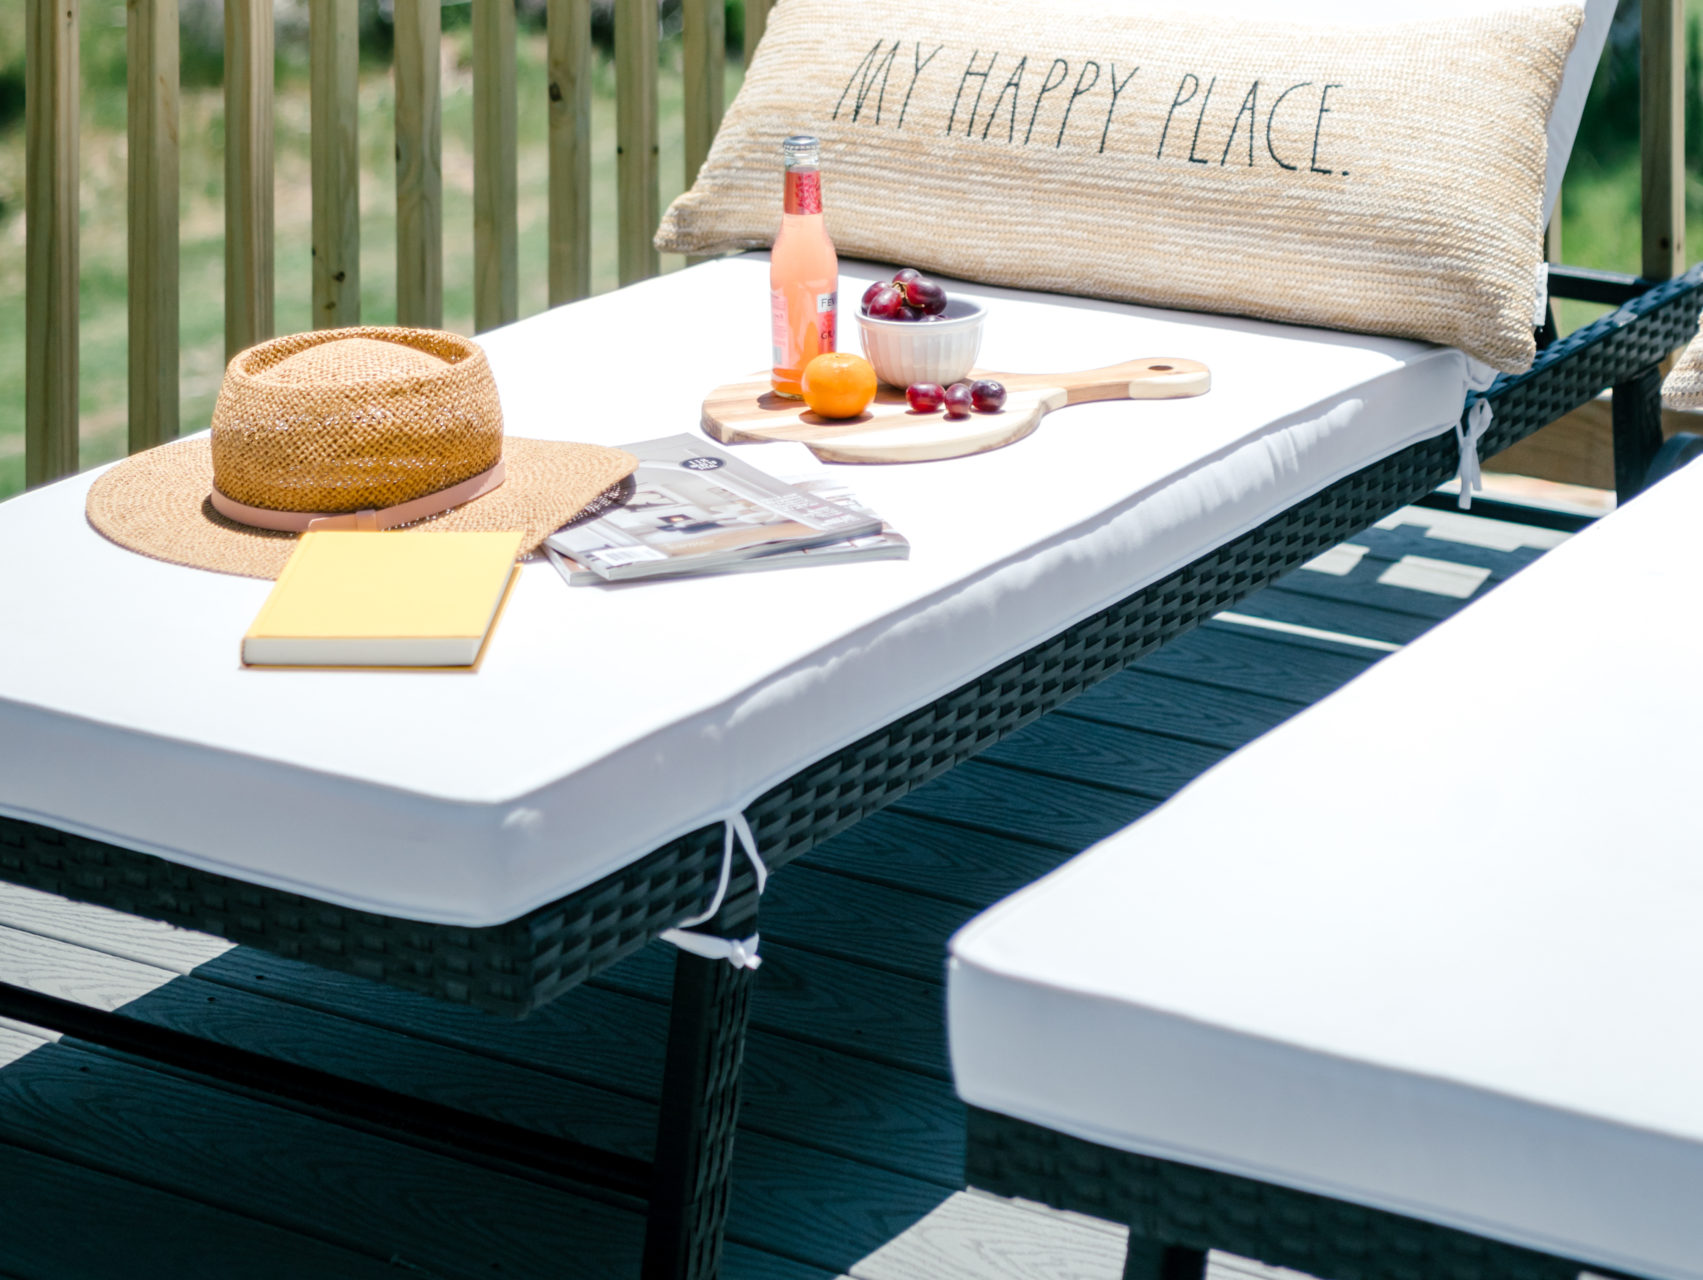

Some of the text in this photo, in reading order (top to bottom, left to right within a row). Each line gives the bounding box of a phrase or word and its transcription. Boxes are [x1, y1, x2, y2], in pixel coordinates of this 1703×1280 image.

[831, 38, 1350, 177] MY HAPPY PLACE.
